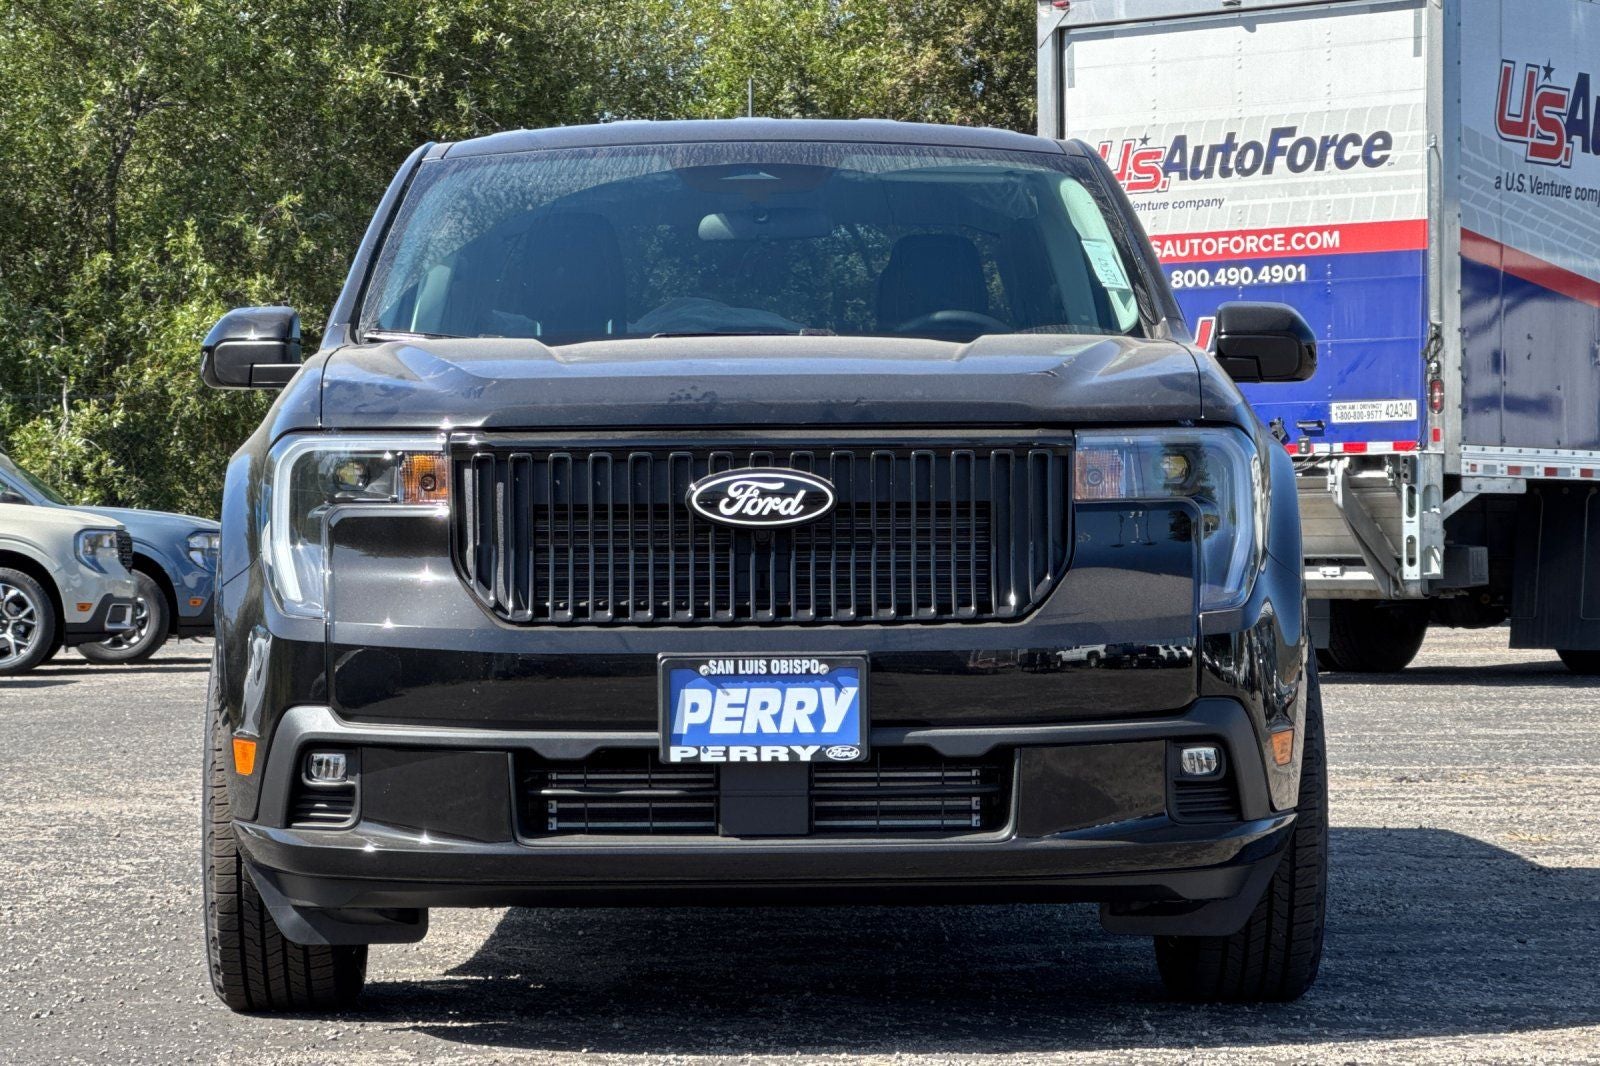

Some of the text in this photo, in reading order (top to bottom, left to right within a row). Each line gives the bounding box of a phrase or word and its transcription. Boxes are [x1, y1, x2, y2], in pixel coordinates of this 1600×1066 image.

[1495, 176, 1501, 190] a
[1506, 172, 1526, 193] U.S.
[1530, 175, 1572, 199] Venture
[1132, 198, 1224, 211] enture company
[1171, 264, 1306, 288] 800.490.4901
[719, 481, 806, 516] Ford
[709, 659, 819, 674] SAN LUIS OBISPO
[673, 687, 858, 735] PERRY
[670, 746, 858, 762] PERRY Ford
